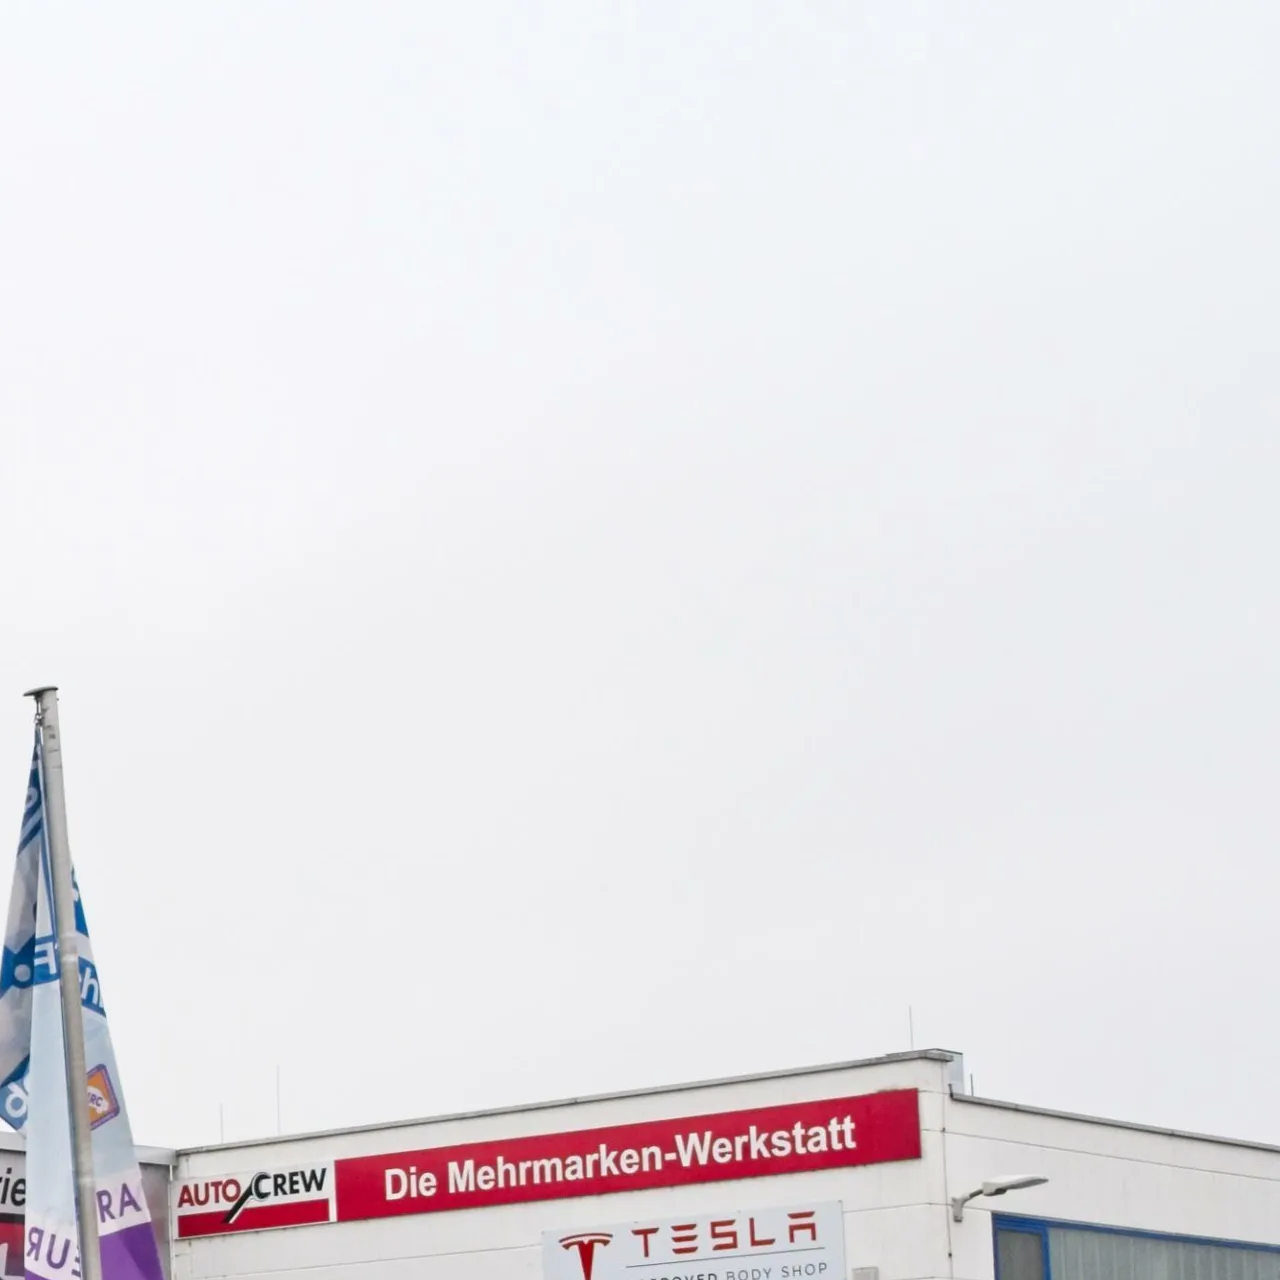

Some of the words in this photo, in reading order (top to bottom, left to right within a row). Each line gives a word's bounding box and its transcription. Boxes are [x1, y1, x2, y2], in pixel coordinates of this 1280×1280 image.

[384, 1165, 437, 1201] Die
[447, 1115, 856, 1194] Mehrmarken-Werkstatt
[177, 1178, 241, 1208] AUTO
[253, 1167, 327, 1199] CREW
[631, 1210, 817, 1258] TESLA
[781, 1262, 828, 1278] SHOP
